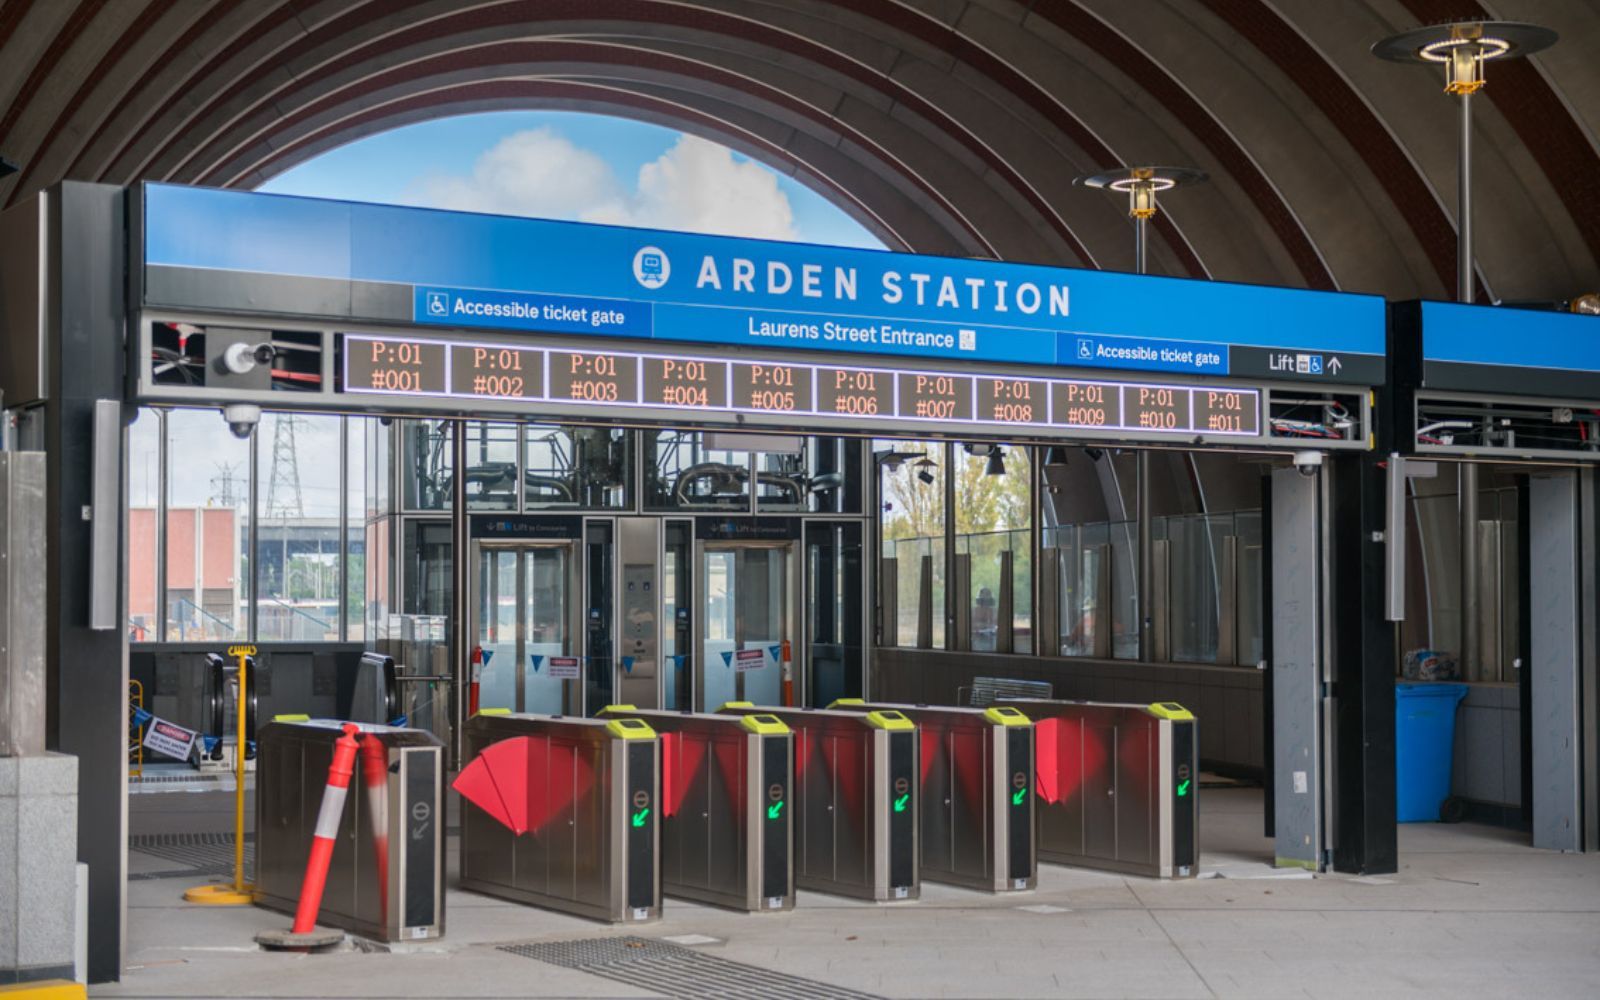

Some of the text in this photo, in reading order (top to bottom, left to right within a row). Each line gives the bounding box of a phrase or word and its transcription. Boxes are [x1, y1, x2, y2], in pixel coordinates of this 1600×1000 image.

[697, 255, 1070, 317] ARDEN STATION
[453, 298, 625, 327] Accessible ticket gate
[748, 316, 955, 349] Laurens Street Entrance
[370, 342, 421, 366] P:01
[473, 348, 521, 372] P:01
[1096, 343, 1220, 368] Accessible ticket gate
[1269, 353, 1295, 373] Lift
[570, 354, 616, 377] P:01
[662, 360, 706, 382] P:01
[751, 365, 793, 387] P:01
[371, 369, 421, 391] #001
[473, 375, 524, 397] #002
[570, 379, 618, 401] #003
[835, 370, 876, 391] P:01
[916, 376, 955, 396] P:01
[993, 380, 1030, 401] P:01
[663, 384, 709, 406] #004
[751, 389, 795, 410] #005
[835, 394, 877, 414] #006
[1068, 385, 1104, 404] P:01
[1139, 389, 1174, 407] P:01
[1208, 392, 1240, 410] P:01
[915, 399, 956, 418] #007
[994, 404, 1033, 421] #008
[1068, 408, 1105, 425] #009
[1139, 411, 1177, 428] #010
[1208, 415, 1241, 431] #011
